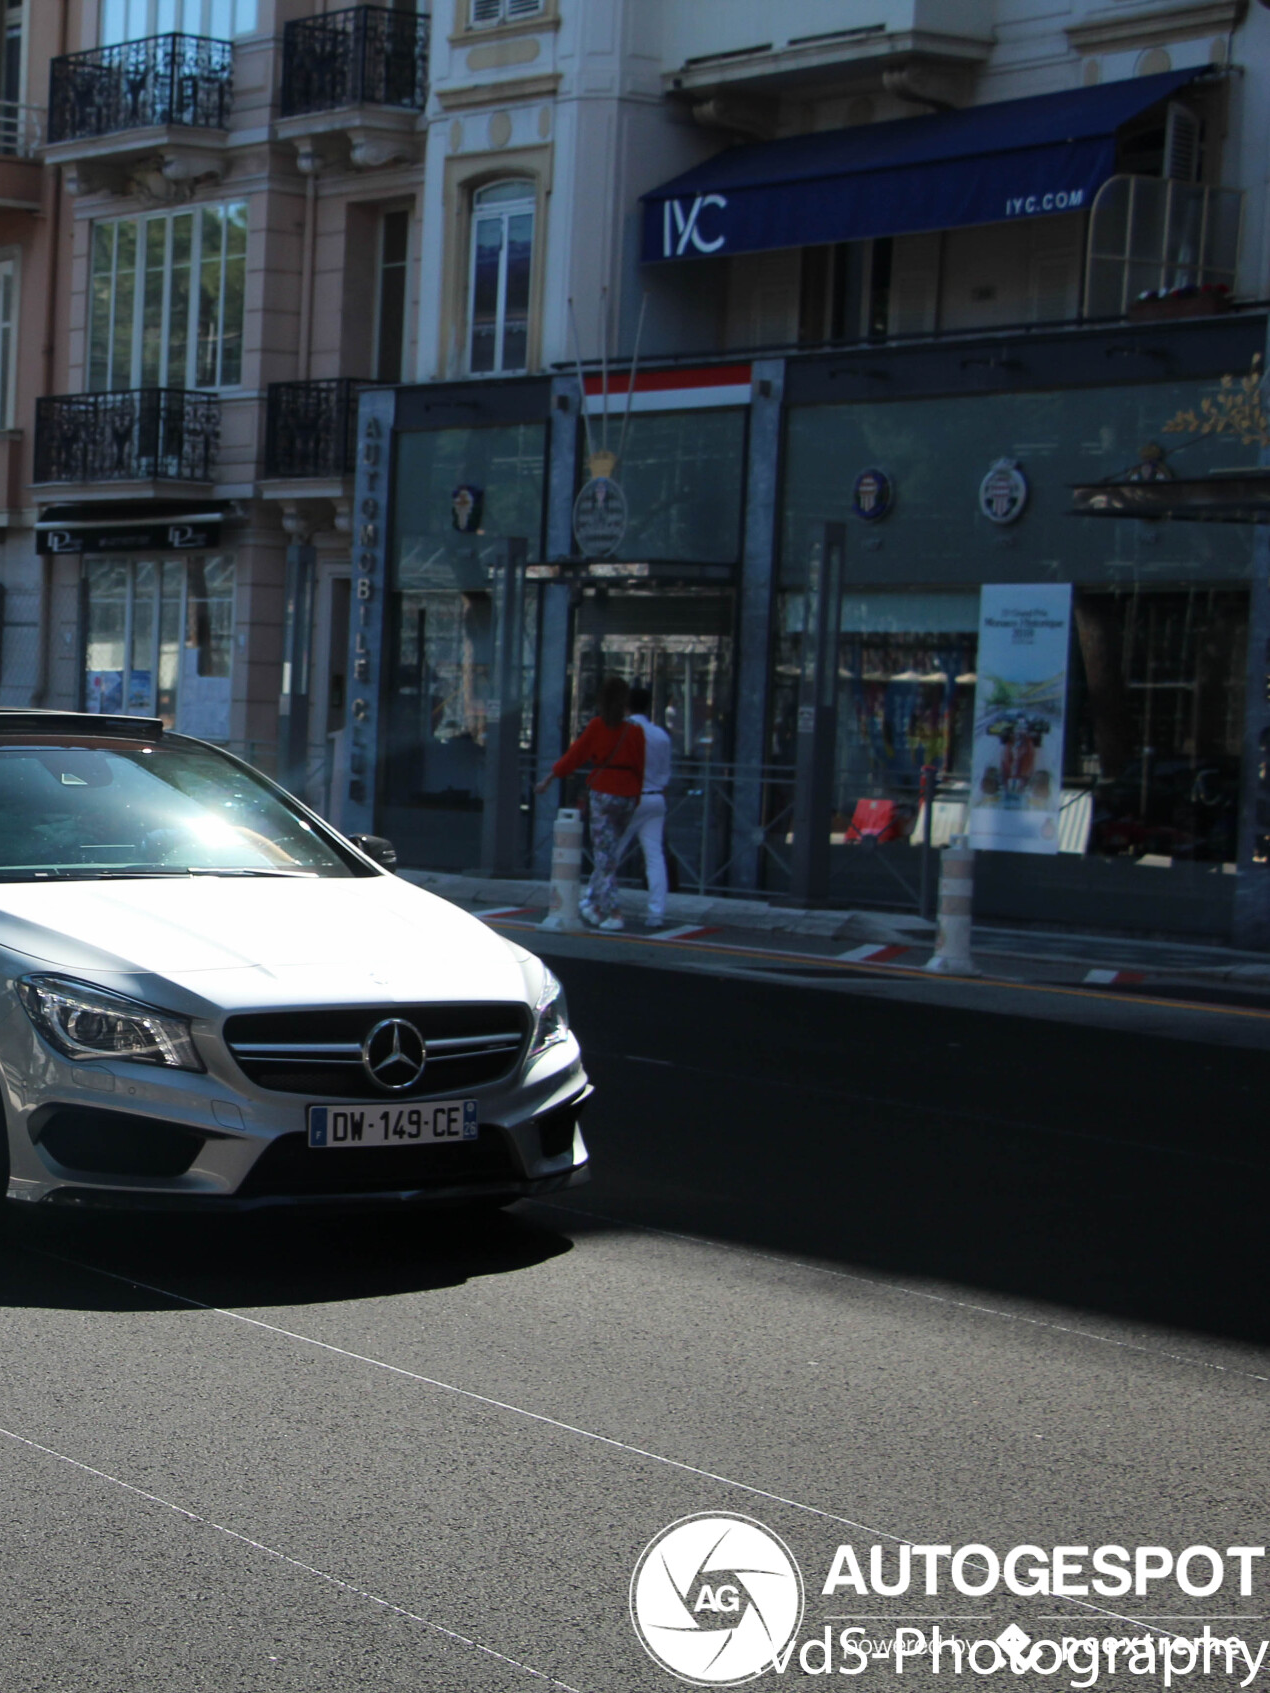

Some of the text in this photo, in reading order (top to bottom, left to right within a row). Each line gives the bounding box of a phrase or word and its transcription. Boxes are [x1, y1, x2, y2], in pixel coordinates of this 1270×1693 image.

[663, 194, 728, 258] IYC
[1005, 188, 1083, 216] IYC.COM
[353, 415, 383, 681] AUTOMOBILE
[332, 1106, 460, 1142] DW-149-CE
[463, 1121, 477, 1136] 26
